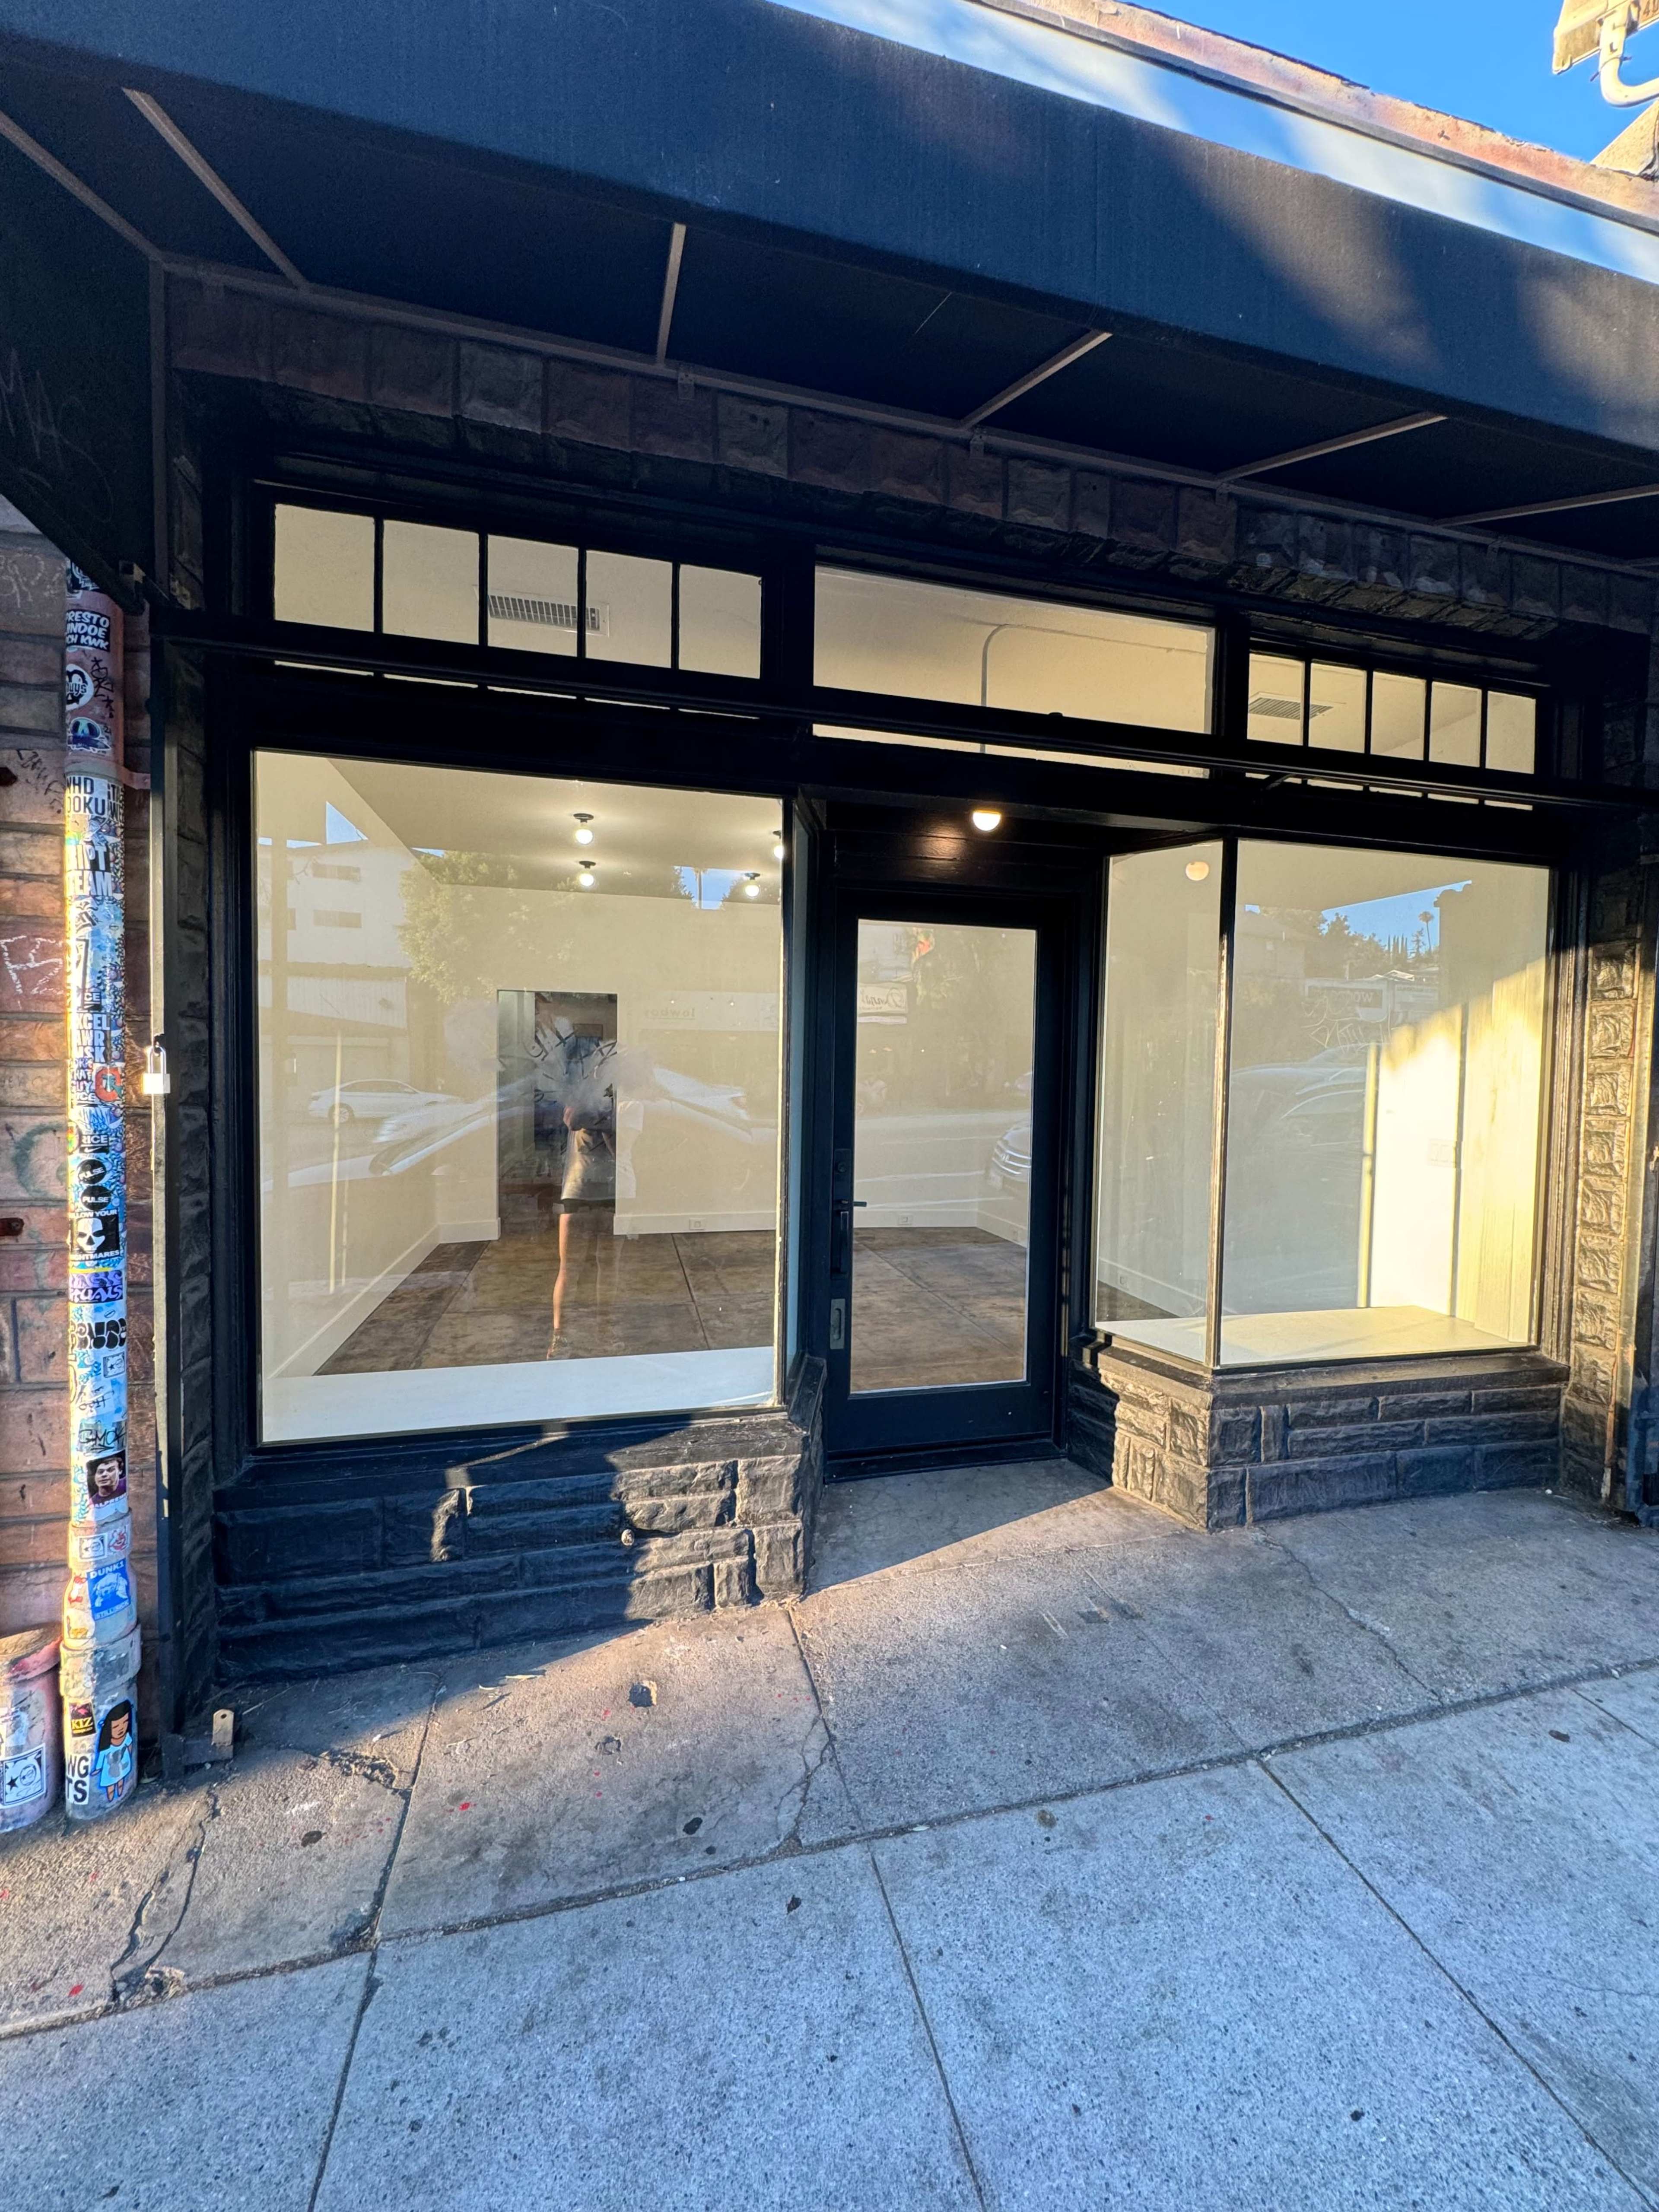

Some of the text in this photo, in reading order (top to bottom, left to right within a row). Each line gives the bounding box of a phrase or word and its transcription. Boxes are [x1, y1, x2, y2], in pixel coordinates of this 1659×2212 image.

[95, 1209, 118, 1217] YOUR
[96, 1608, 114, 1619] STILL
[71, 1717, 93, 1729] KIZ
